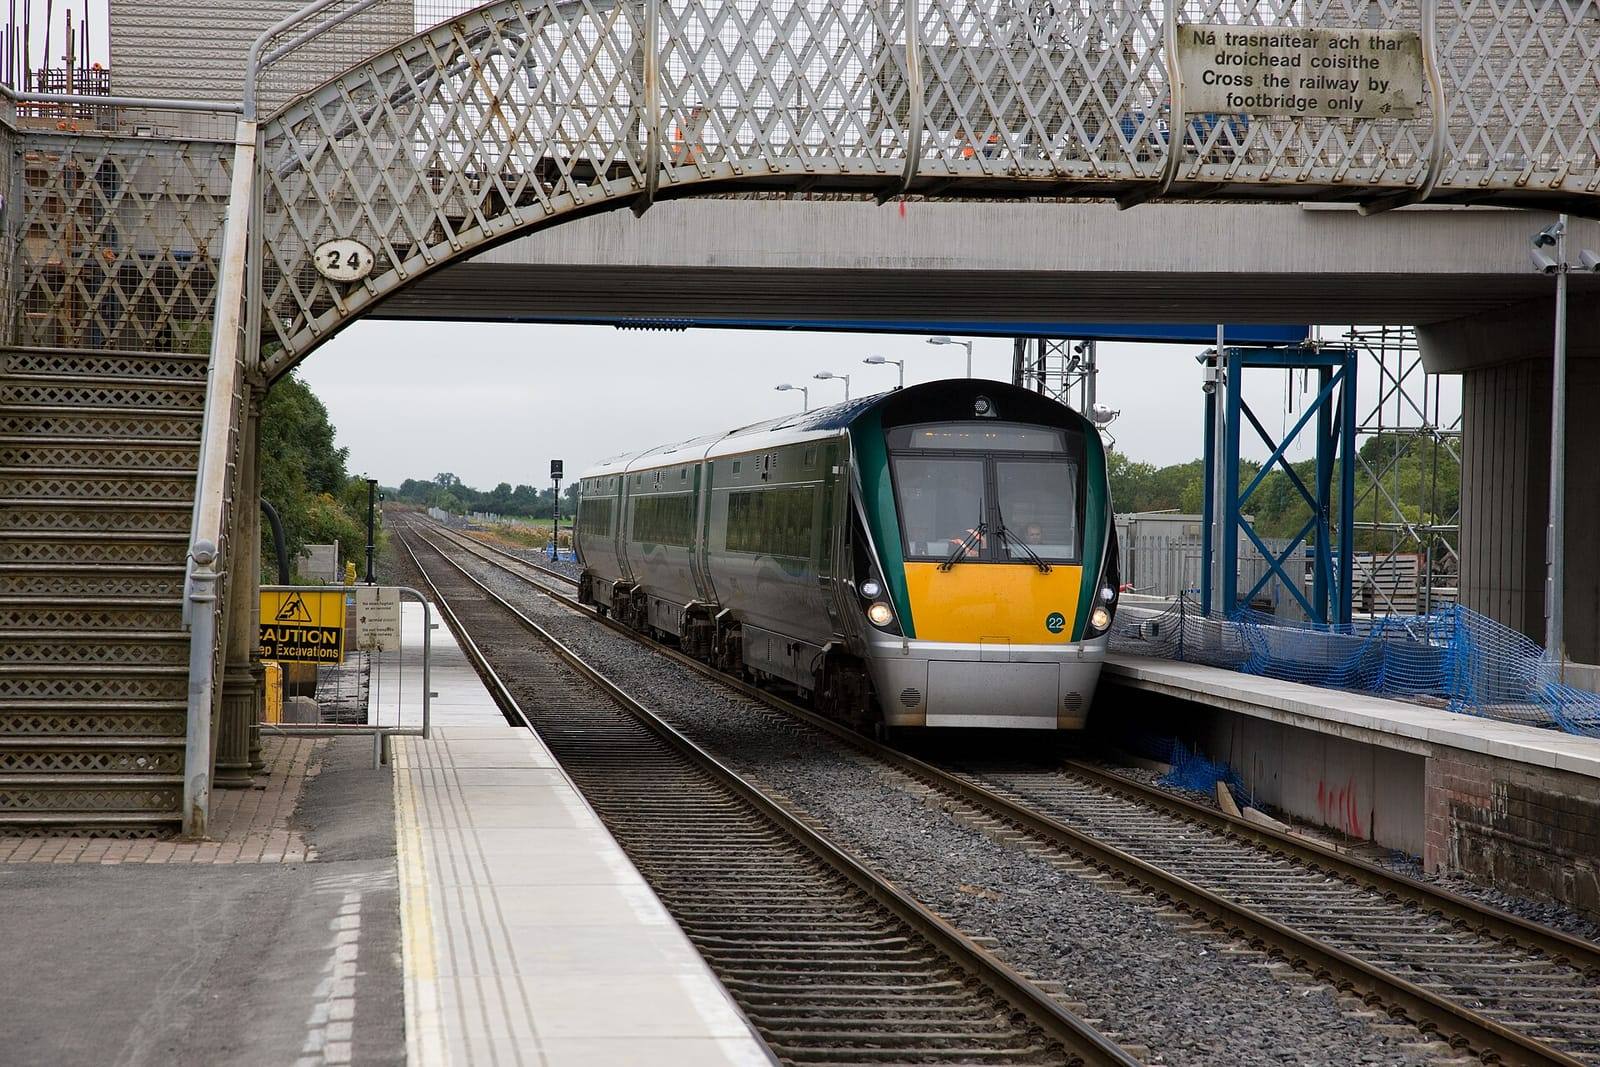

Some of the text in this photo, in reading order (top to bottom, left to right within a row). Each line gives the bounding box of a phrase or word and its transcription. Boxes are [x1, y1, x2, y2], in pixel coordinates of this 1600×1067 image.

[1193, 30, 1216, 46] Ná
[1328, 35, 1360, 50] ach
[1369, 36, 1404, 51] thar
[1214, 51, 1301, 67] droichead
[1202, 70, 1390, 93] Cross the railway by
[1226, 92, 1364, 113] footbridge only
[326, 250, 360, 270] 24
[1048, 617, 1064, 629] 22
[277, 643, 339, 658] Excavations
